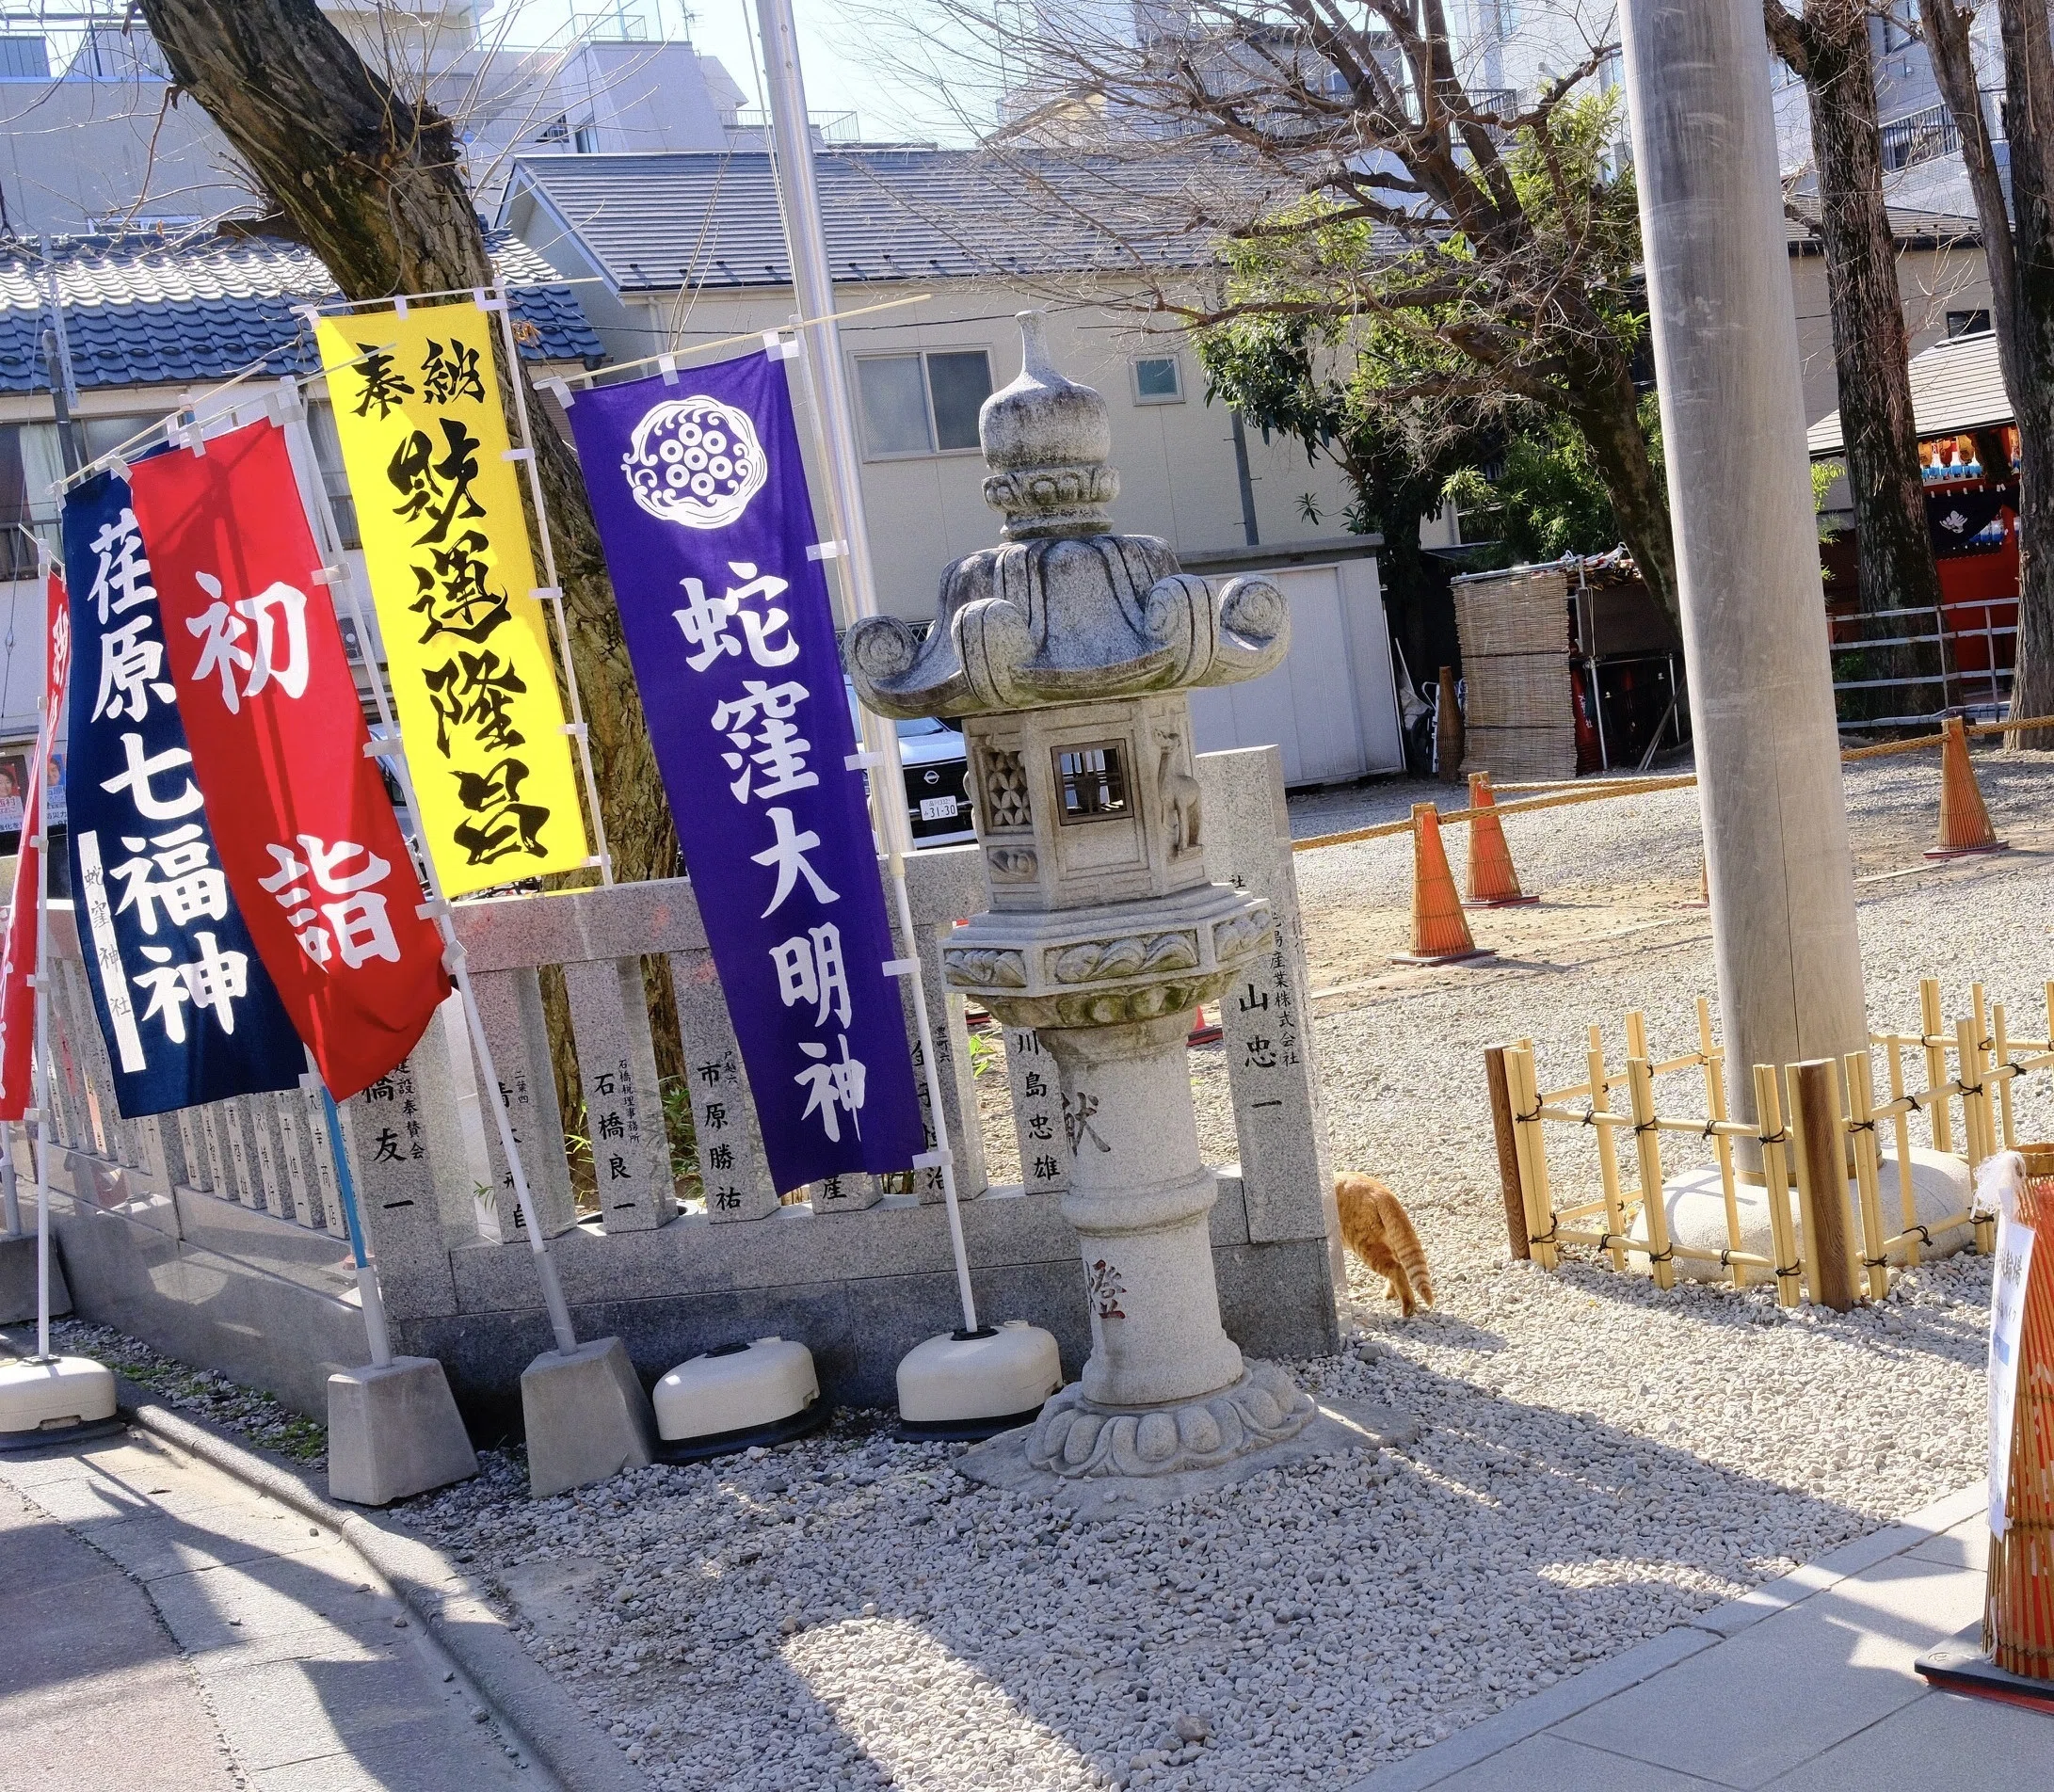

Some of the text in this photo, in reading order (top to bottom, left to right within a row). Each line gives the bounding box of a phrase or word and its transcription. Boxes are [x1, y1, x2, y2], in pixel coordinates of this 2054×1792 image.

[351, 337, 486, 420] 奉納
[87, 505, 248, 1045] 荏原七福神
[185, 570, 401, 975] 初詣
[930, 805, 955, 817] 31-30
[671, 562, 867, 1143] 蛇窪大明神
[84, 865, 132, 1017] 蛇窪神社
[593, 1073, 636, 1210] 石橋良一
[618, 1059, 640, 1144] 石橋税理事務所
[697, 1061, 742, 1211] 市原勝祐
[724, 1050, 739, 1084] 戸越六
[1018, 1030, 1061, 1181] 川島忠雄
